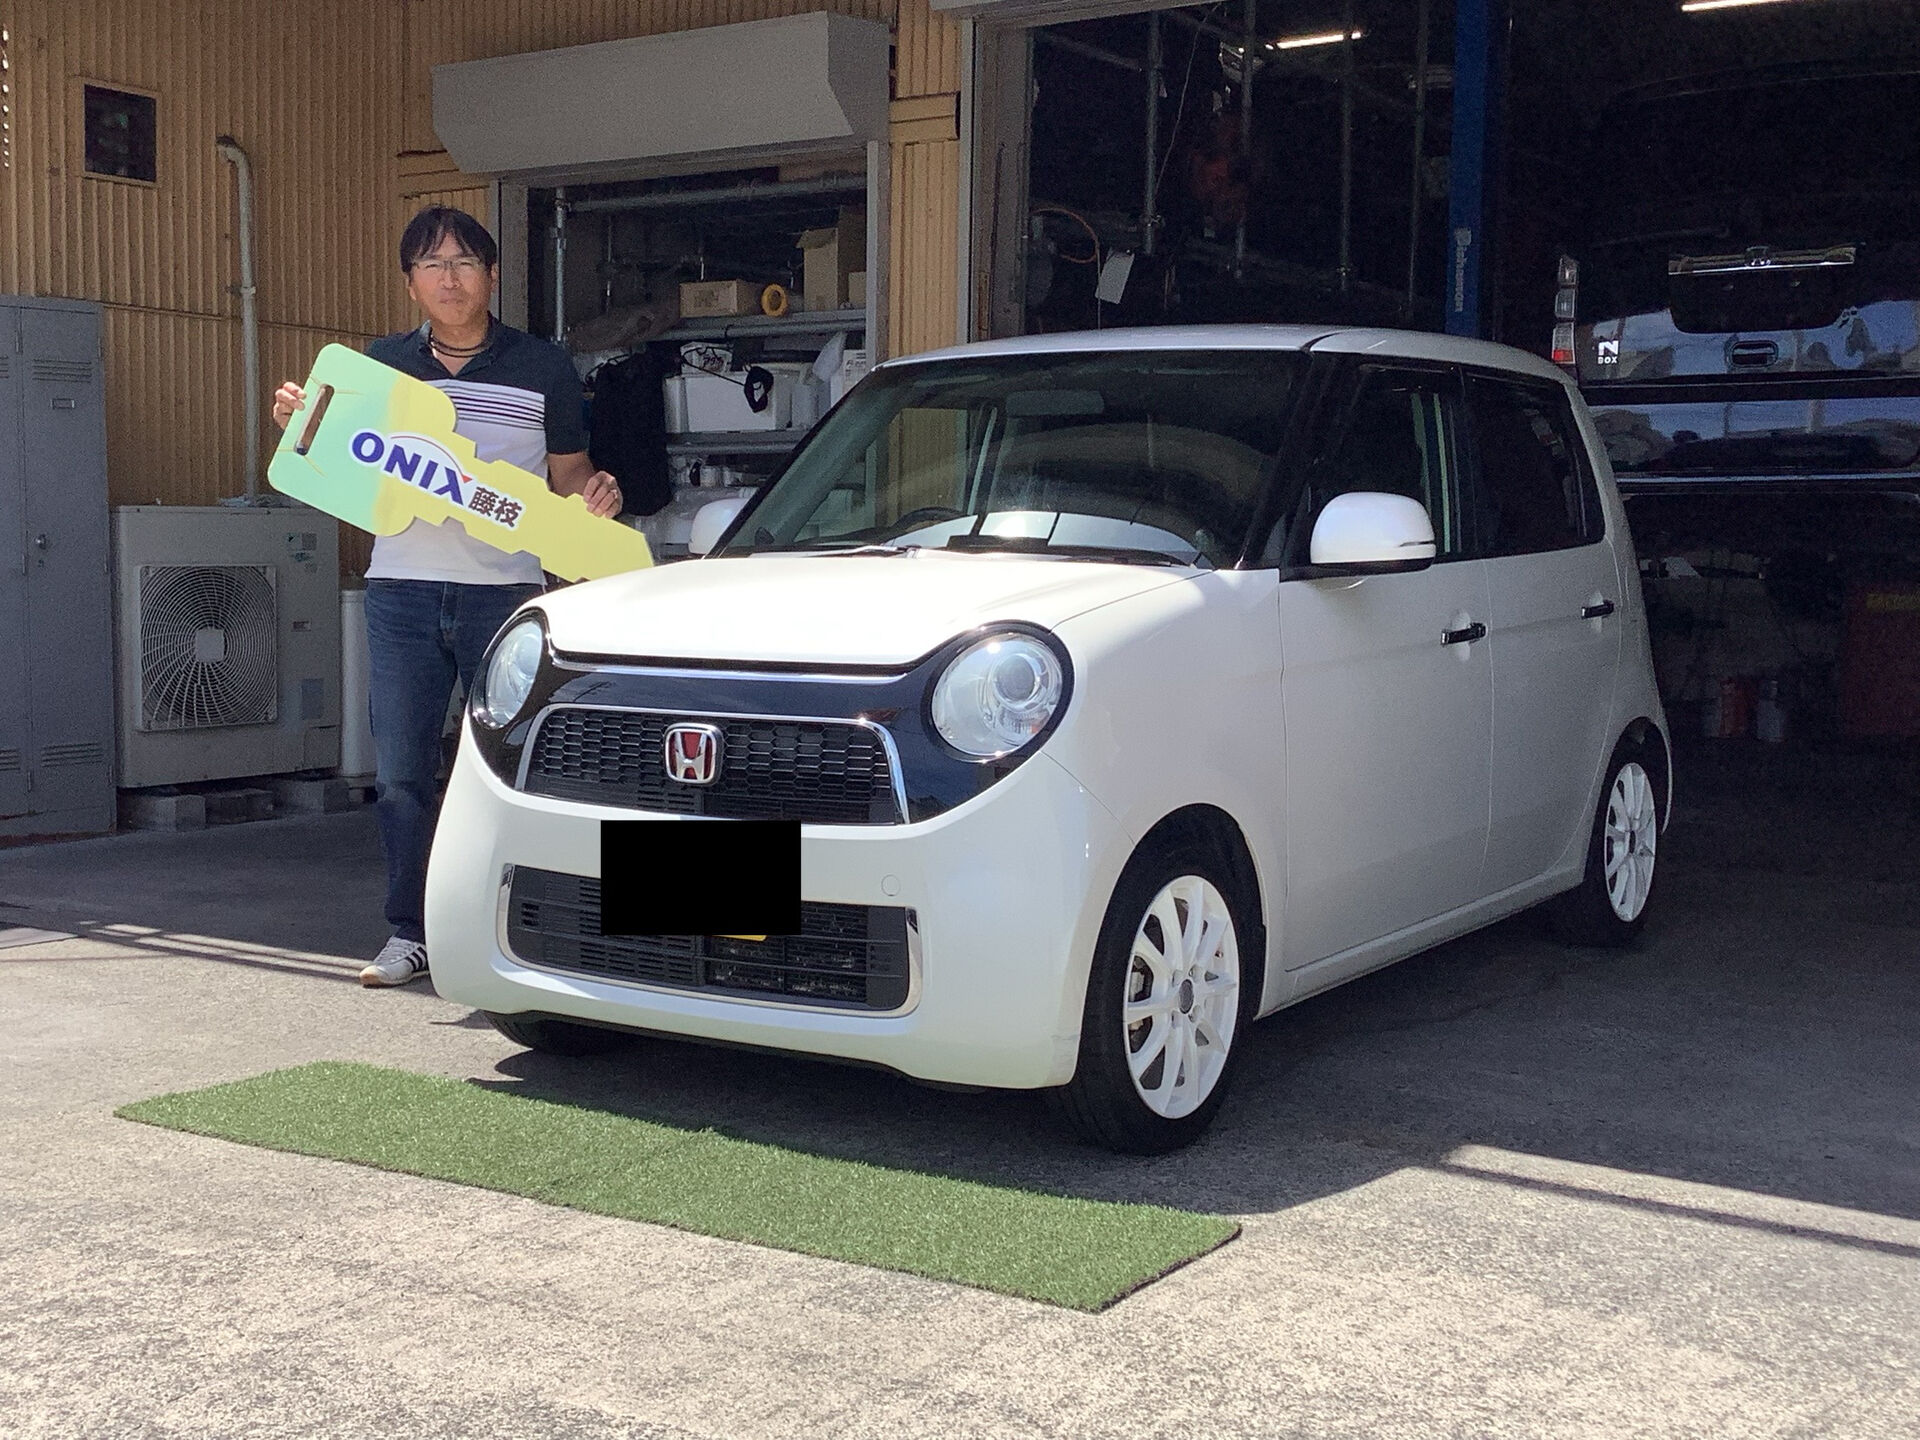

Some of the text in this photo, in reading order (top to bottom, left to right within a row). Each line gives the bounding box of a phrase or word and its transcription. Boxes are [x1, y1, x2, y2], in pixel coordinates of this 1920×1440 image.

[1598, 340, 1619, 356] N
[1597, 356, 1618, 365] BOX
[352, 432, 523, 528] ONIX 藤枝
